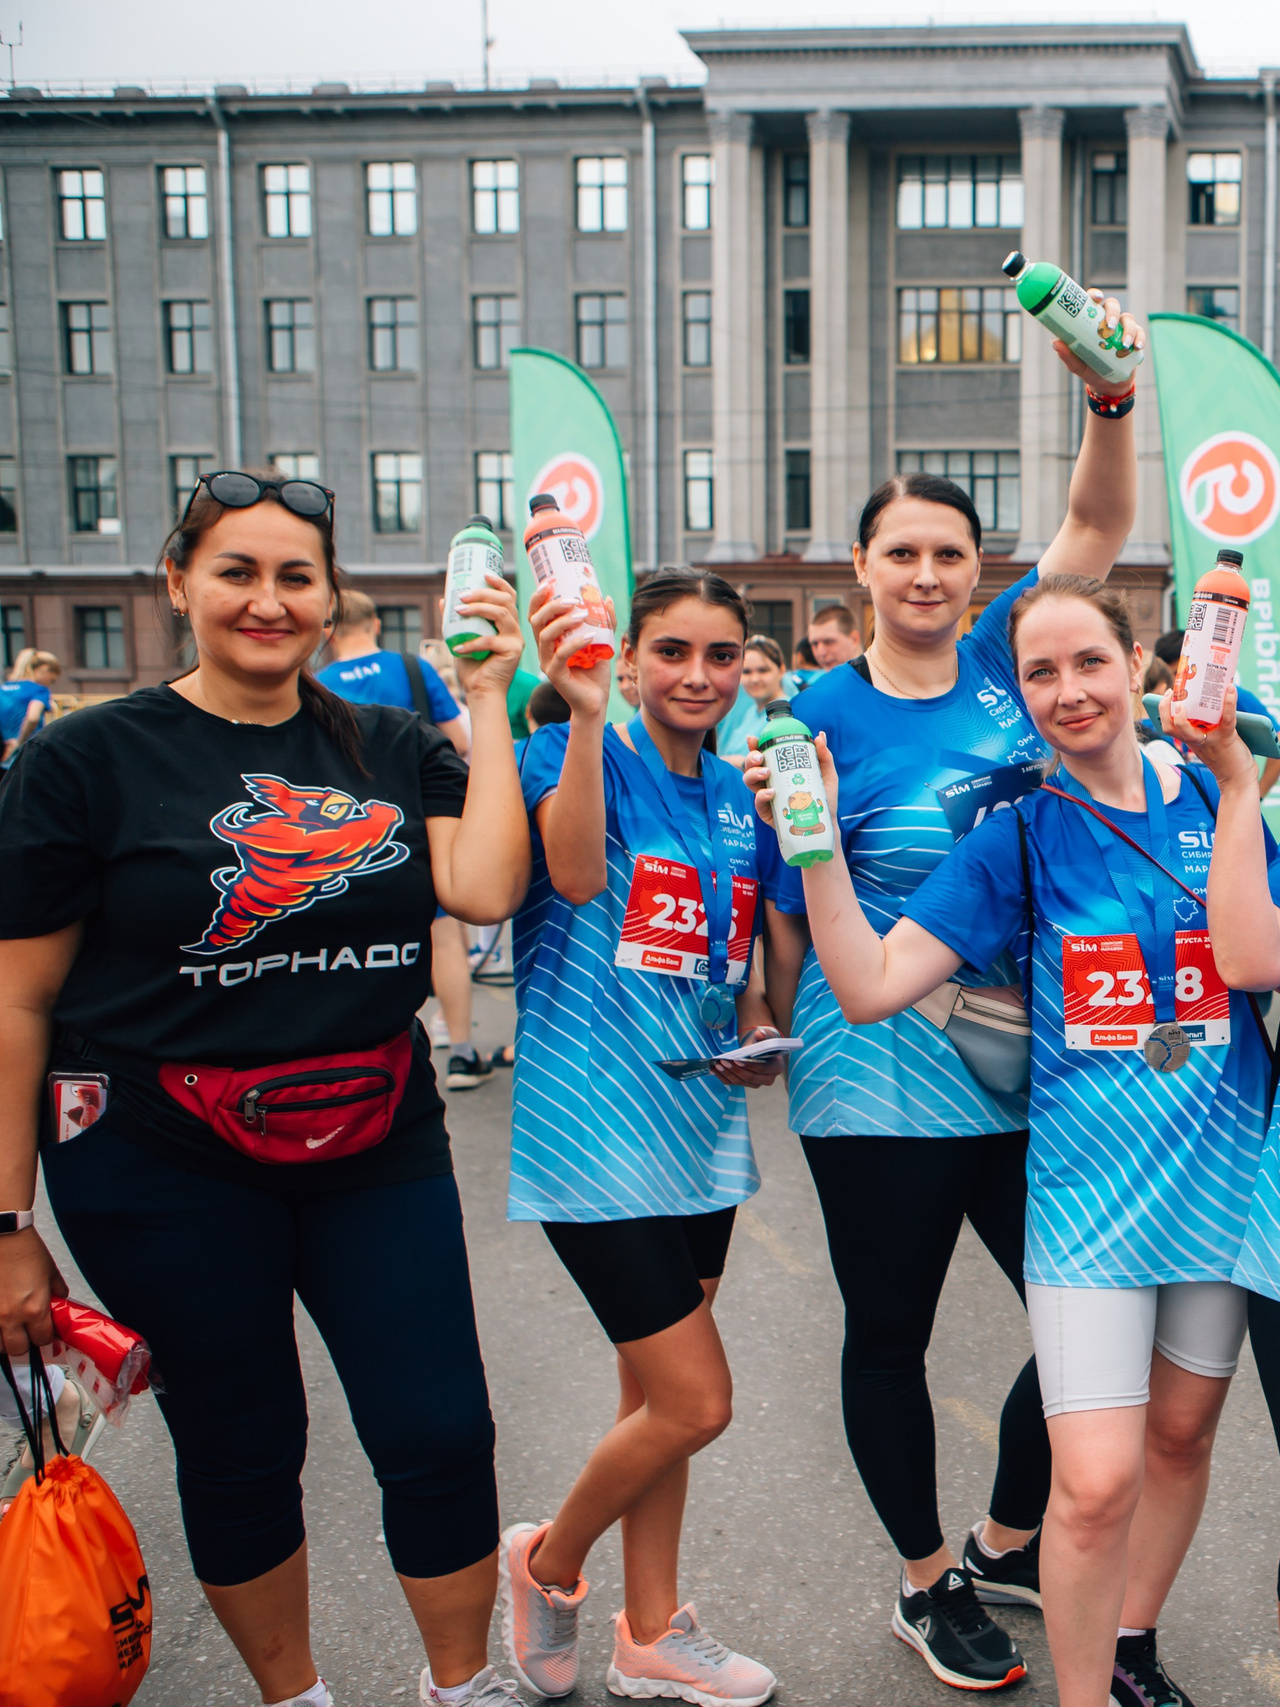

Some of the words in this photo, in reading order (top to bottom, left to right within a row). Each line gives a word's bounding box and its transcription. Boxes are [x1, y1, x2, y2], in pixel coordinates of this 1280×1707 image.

[645, 953, 666, 966] Альфа
[1094, 1033, 1116, 1042] Альфа
[1117, 1033, 1134, 1041] Банк
